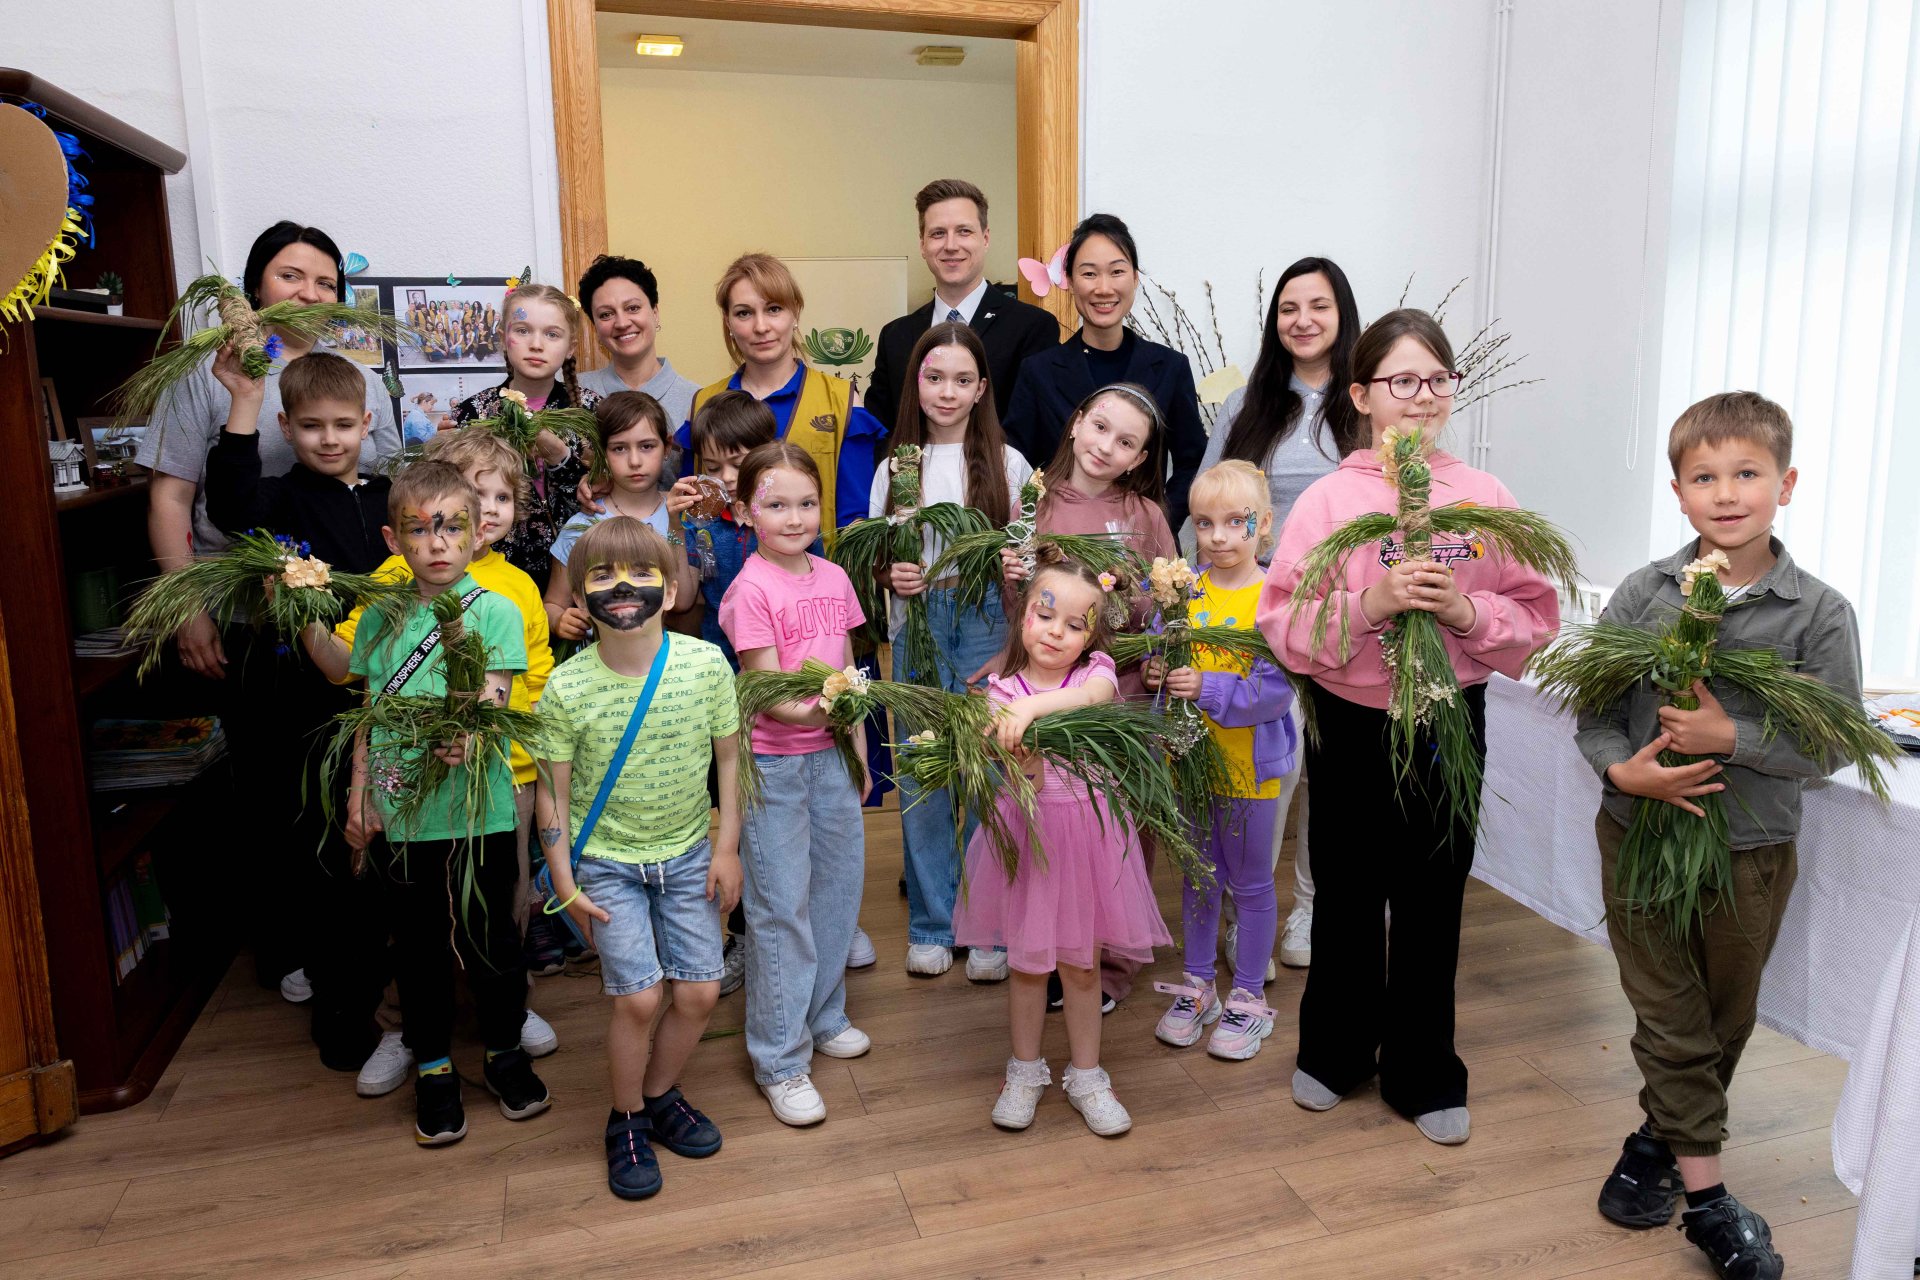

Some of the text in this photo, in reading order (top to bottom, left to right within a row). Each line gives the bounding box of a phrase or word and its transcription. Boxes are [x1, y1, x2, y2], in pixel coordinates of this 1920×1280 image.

[1383, 548, 1471, 561] POPUFF
[775, 597, 848, 647] LOVE
[675, 662, 692, 670] KIND
[385, 650, 424, 696] ATMOSPHERE
[561, 668, 584, 677] COOL
[576, 677, 593, 686] KIND
[663, 677, 684, 685] COOL
[695, 672, 705, 680] BE
[610, 682, 629, 690] KIND
[564, 692, 586, 702] COOL
[662, 689, 693, 700] BE KIND
[614, 696, 640, 705] BE CO
[566, 702, 597, 715] BE KIND
[648, 704, 684, 715] BE COOL
[611, 710, 629, 718] KIND
[675, 716, 691, 725] KIND
[660, 741, 690, 752] BE KIND
[645, 755, 681, 766] BE COOL
[672, 765, 689, 773] KIND
[659, 779, 680, 788] COOL
[672, 787, 687, 796] KIND
[658, 802, 678, 810] COOL
[622, 812, 643, 821] COOL
[668, 808, 683, 816] KIND
[616, 830, 639, 840] COOL
